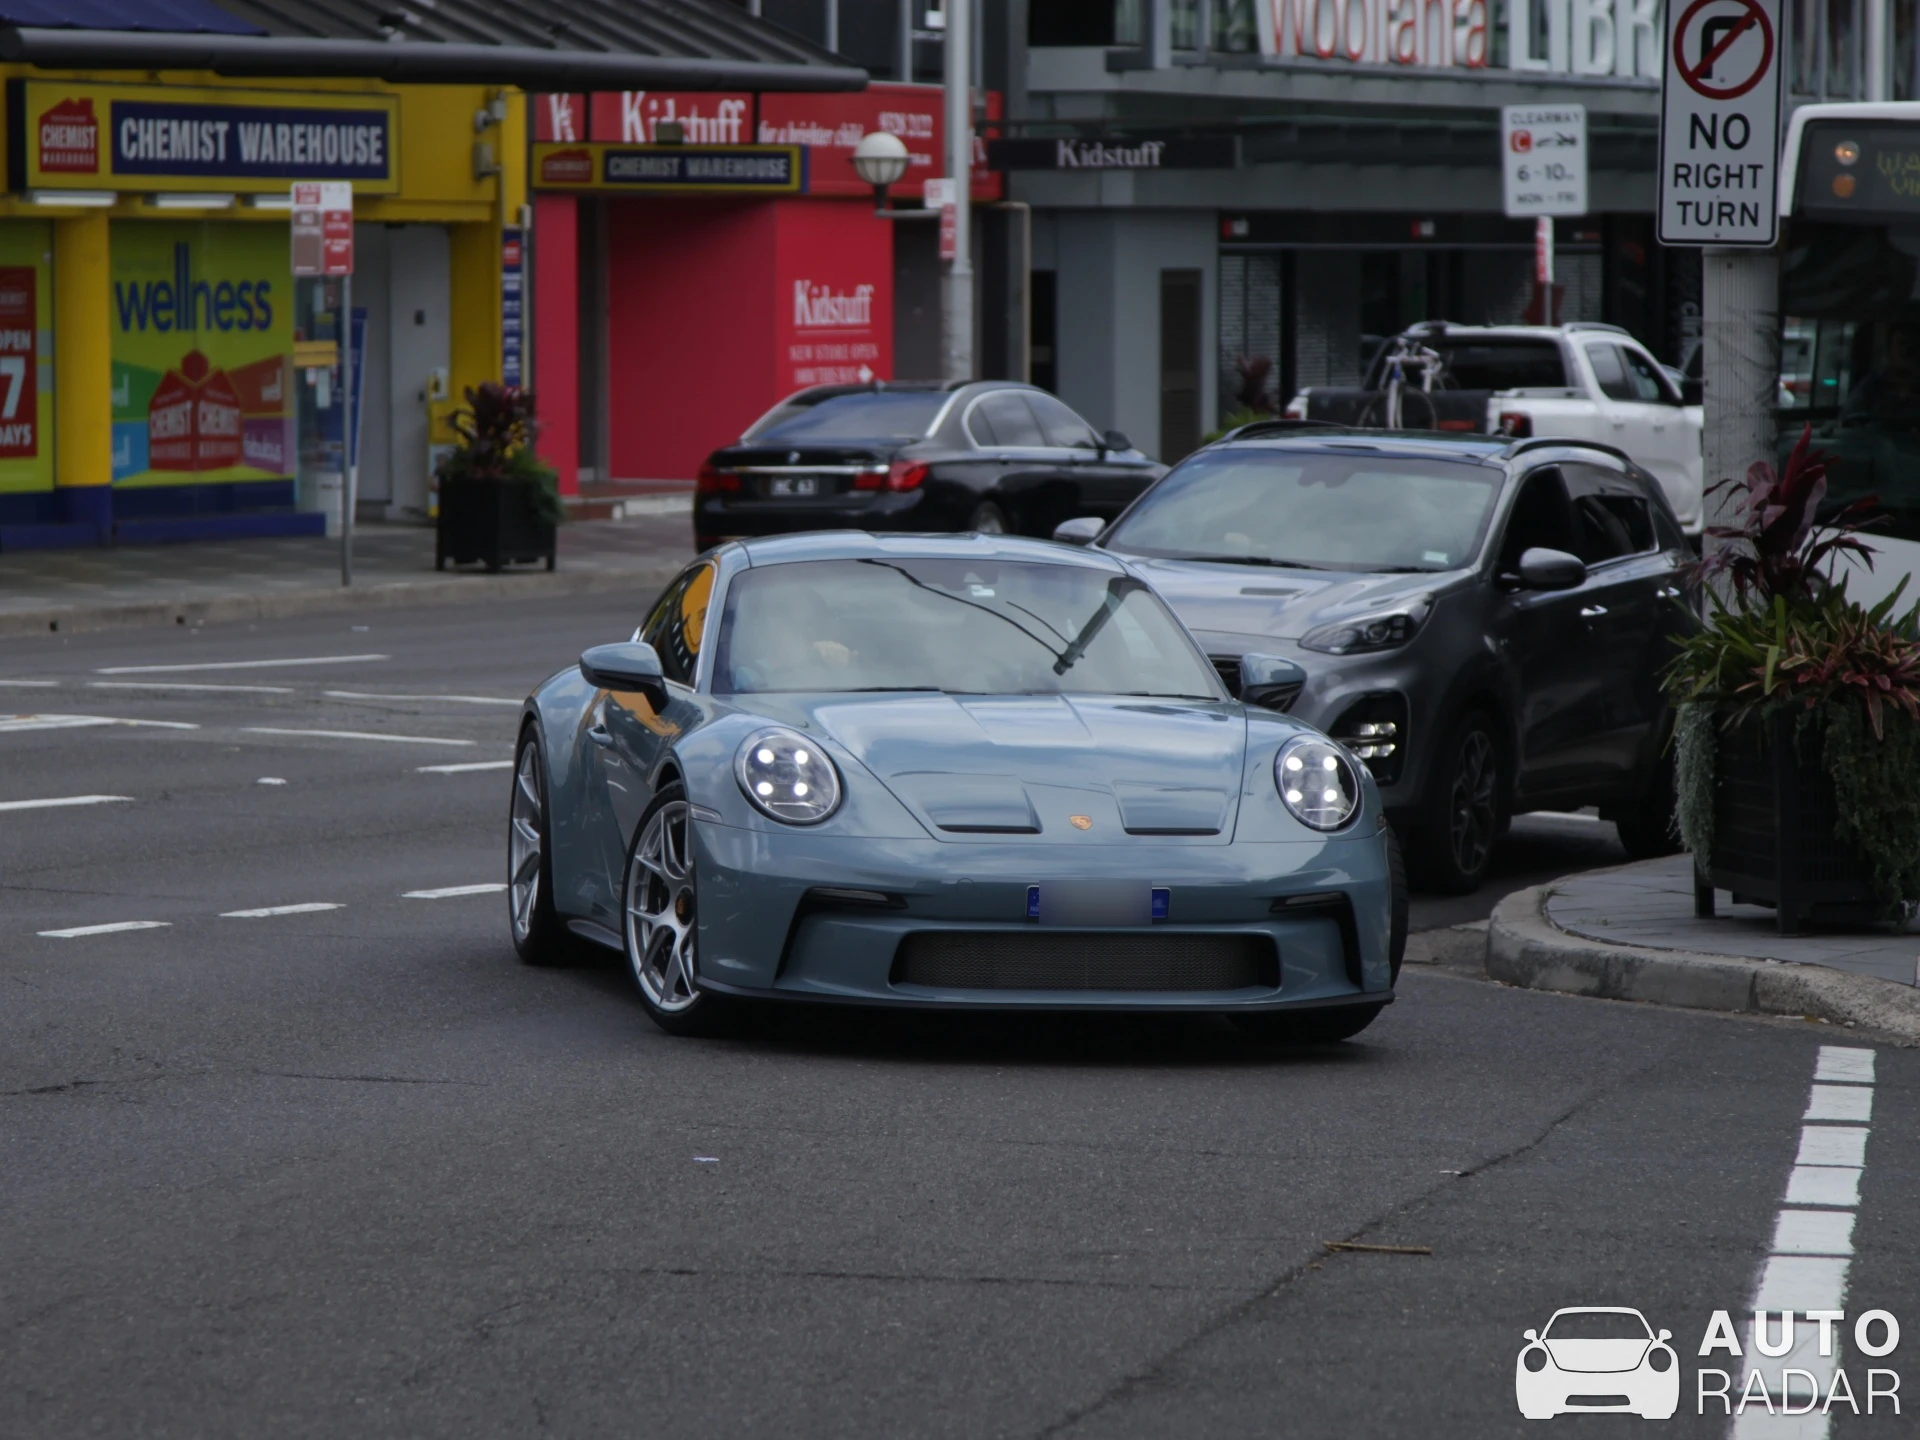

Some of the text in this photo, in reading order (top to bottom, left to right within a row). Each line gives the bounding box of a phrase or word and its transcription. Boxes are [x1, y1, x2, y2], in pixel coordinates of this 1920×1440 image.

[1510, 112, 1580, 125] CLEARWAY
[1690, 113, 1750, 150] NO
[42, 124, 97, 150] CHEMIST
[120, 117, 383, 166] CHEMIST WAREHOUSE
[1057, 139, 1166, 168] Kidstuff
[608, 156, 682, 177] CHEMIST
[686, 157, 789, 180] WAREHOUSE
[1517, 163, 1530, 182] 6
[1545, 162, 1566, 182] 10
[1674, 163, 1764, 189] RIGHT
[1676, 201, 1760, 227] TURN
[115, 241, 273, 333] wellness
[794, 279, 875, 327] Kidstuff
[0, 356, 26, 420] 7
